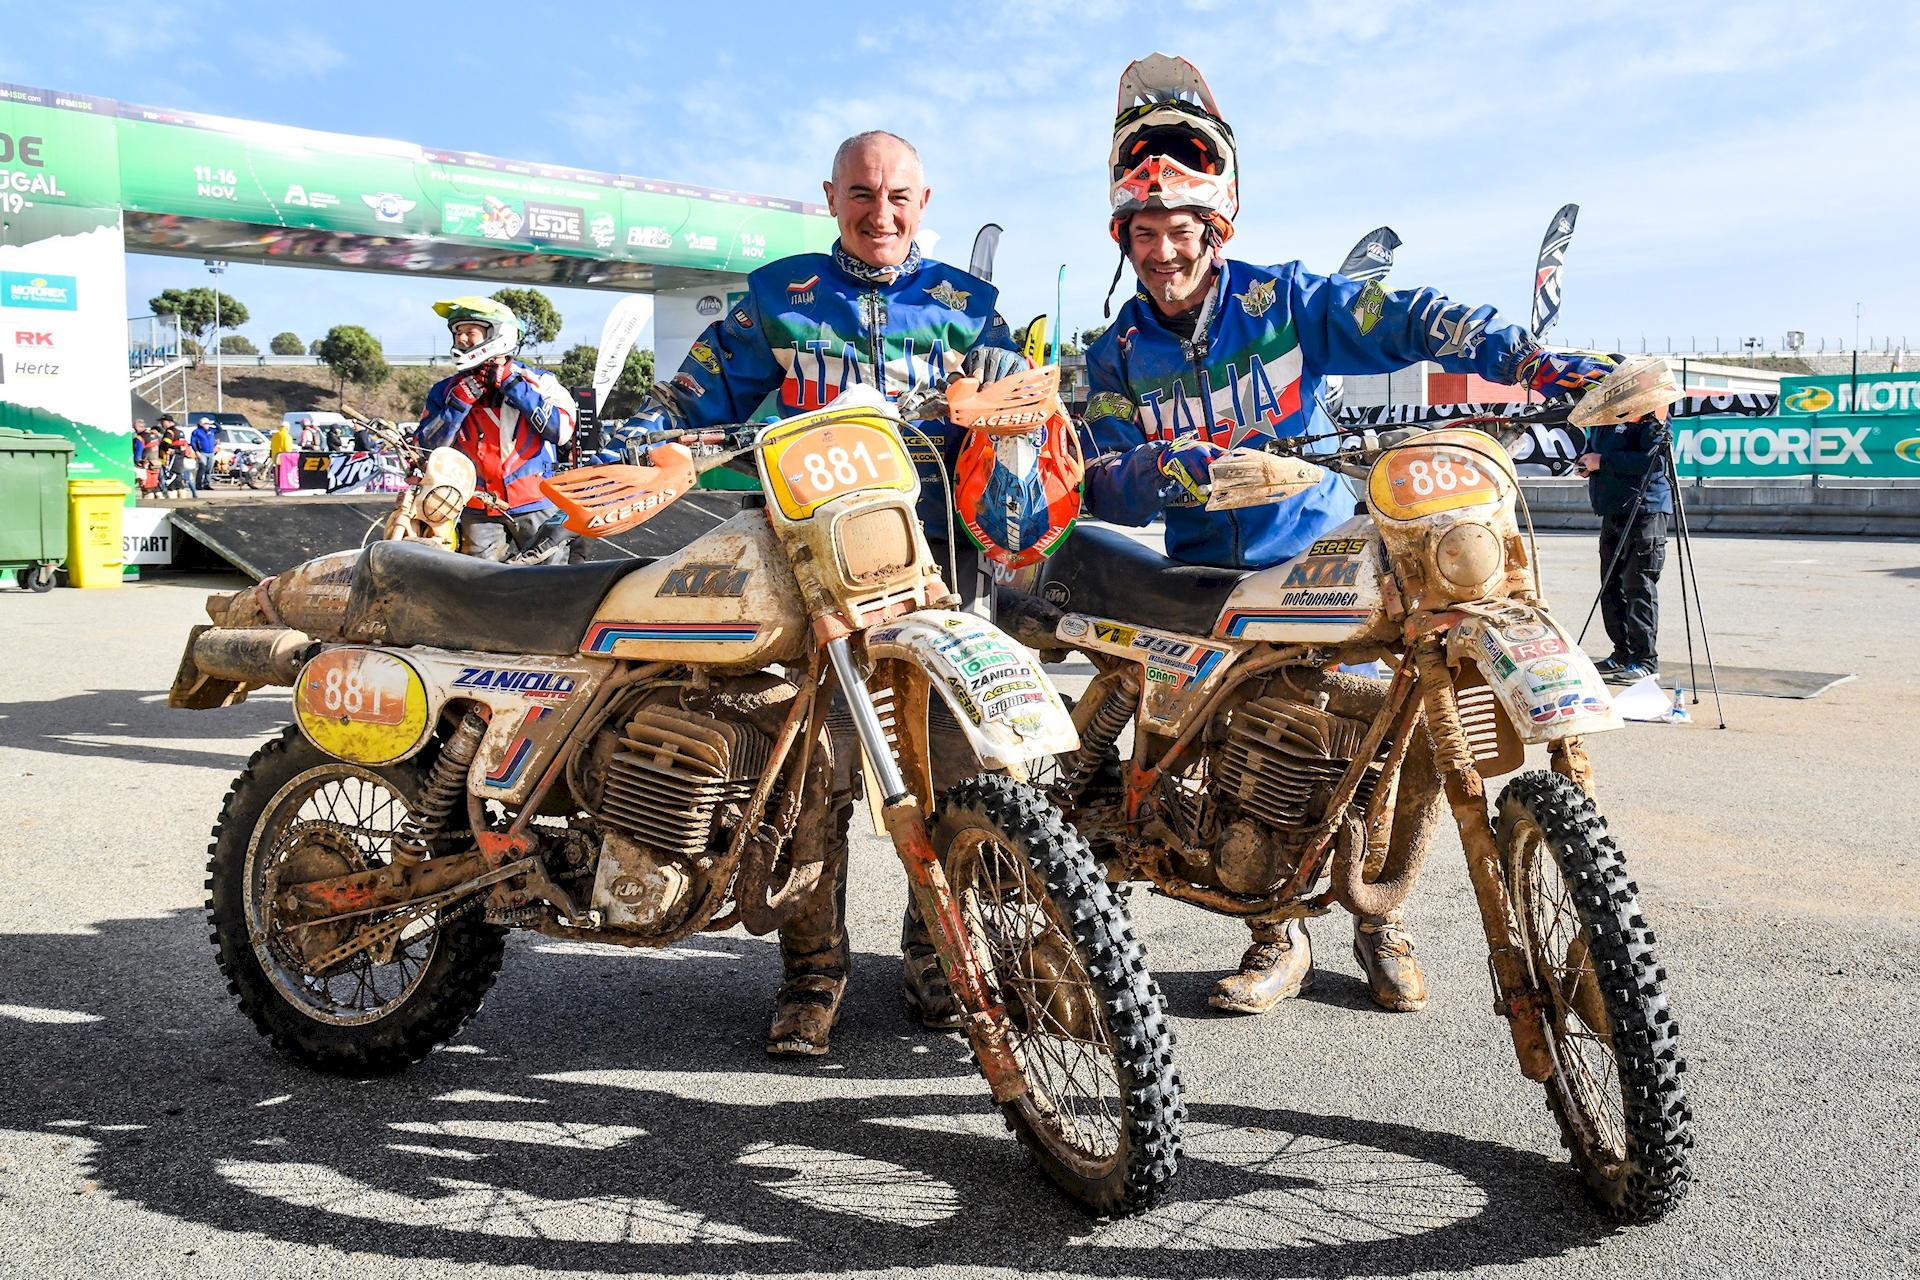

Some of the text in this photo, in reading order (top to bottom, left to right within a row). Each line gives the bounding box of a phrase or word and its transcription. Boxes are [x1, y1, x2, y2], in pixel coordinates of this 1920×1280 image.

[194, 166, 237, 185] 11-16
[198, 183, 238, 201] NOV.
[529, 213, 581, 236] ISDE
[741, 233, 766, 247] 11-16
[742, 247, 767, 259] NOV.
[10, 285, 68, 299] MOTOREX
[15, 331, 54, 346] RK
[15, 361, 60, 376] Hertz
[1838, 381, 1920, 412] MOT
[1408, 453, 1480, 496] 883
[123, 536, 169, 552] START
[967, 521, 995, 551] ITALIA
[1032, 525, 1064, 552] ITALIA
[655, 563, 750, 598] KTM
[1045, 589, 1066, 602] KTM
[1132, 633, 1192, 659] 350
[1518, 642, 1560, 659] RG
[454, 668, 576, 693] ZANIOLO
[1148, 668, 1178, 684] ORAM
[324, 667, 384, 716] 881
[523, 690, 569, 699] MOTO
[982, 681, 1037, 702] ACERBIS
[614, 882, 643, 897] KTM
